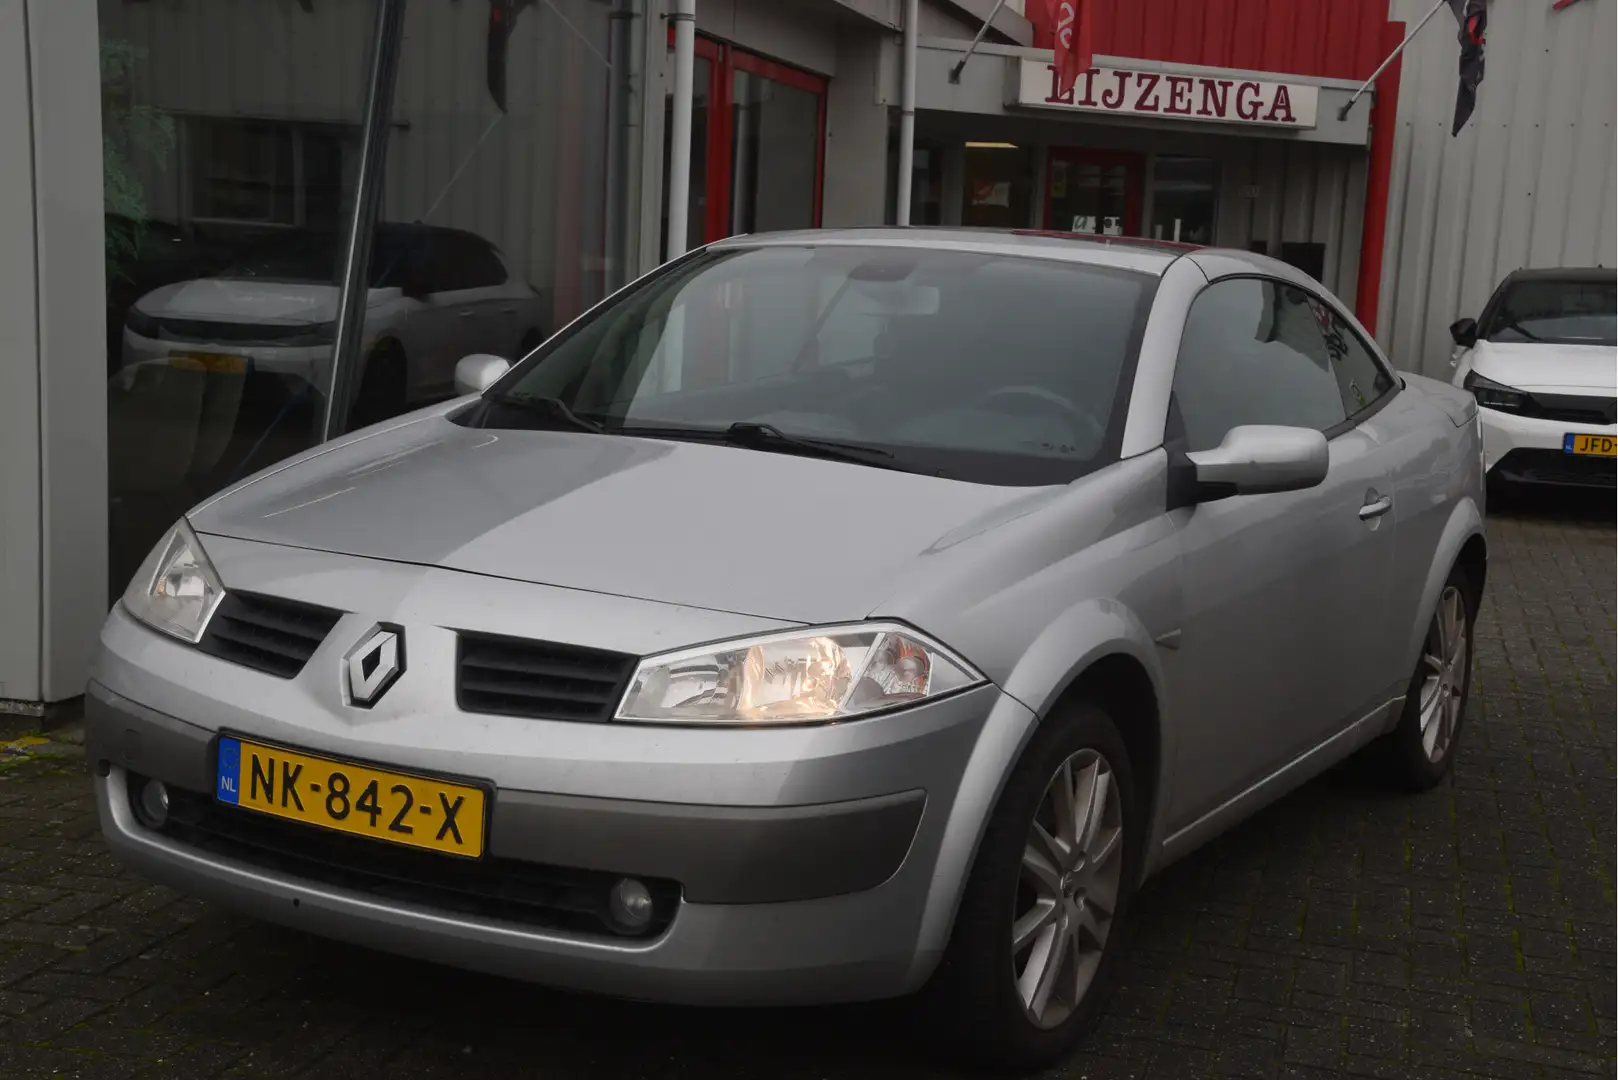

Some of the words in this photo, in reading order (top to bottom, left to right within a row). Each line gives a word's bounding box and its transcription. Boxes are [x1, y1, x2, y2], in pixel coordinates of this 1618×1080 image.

[1045, 65, 1297, 123] LIJZENGA
[221, 775, 237, 793] NL
[250, 753, 465, 845] NK-842-X
